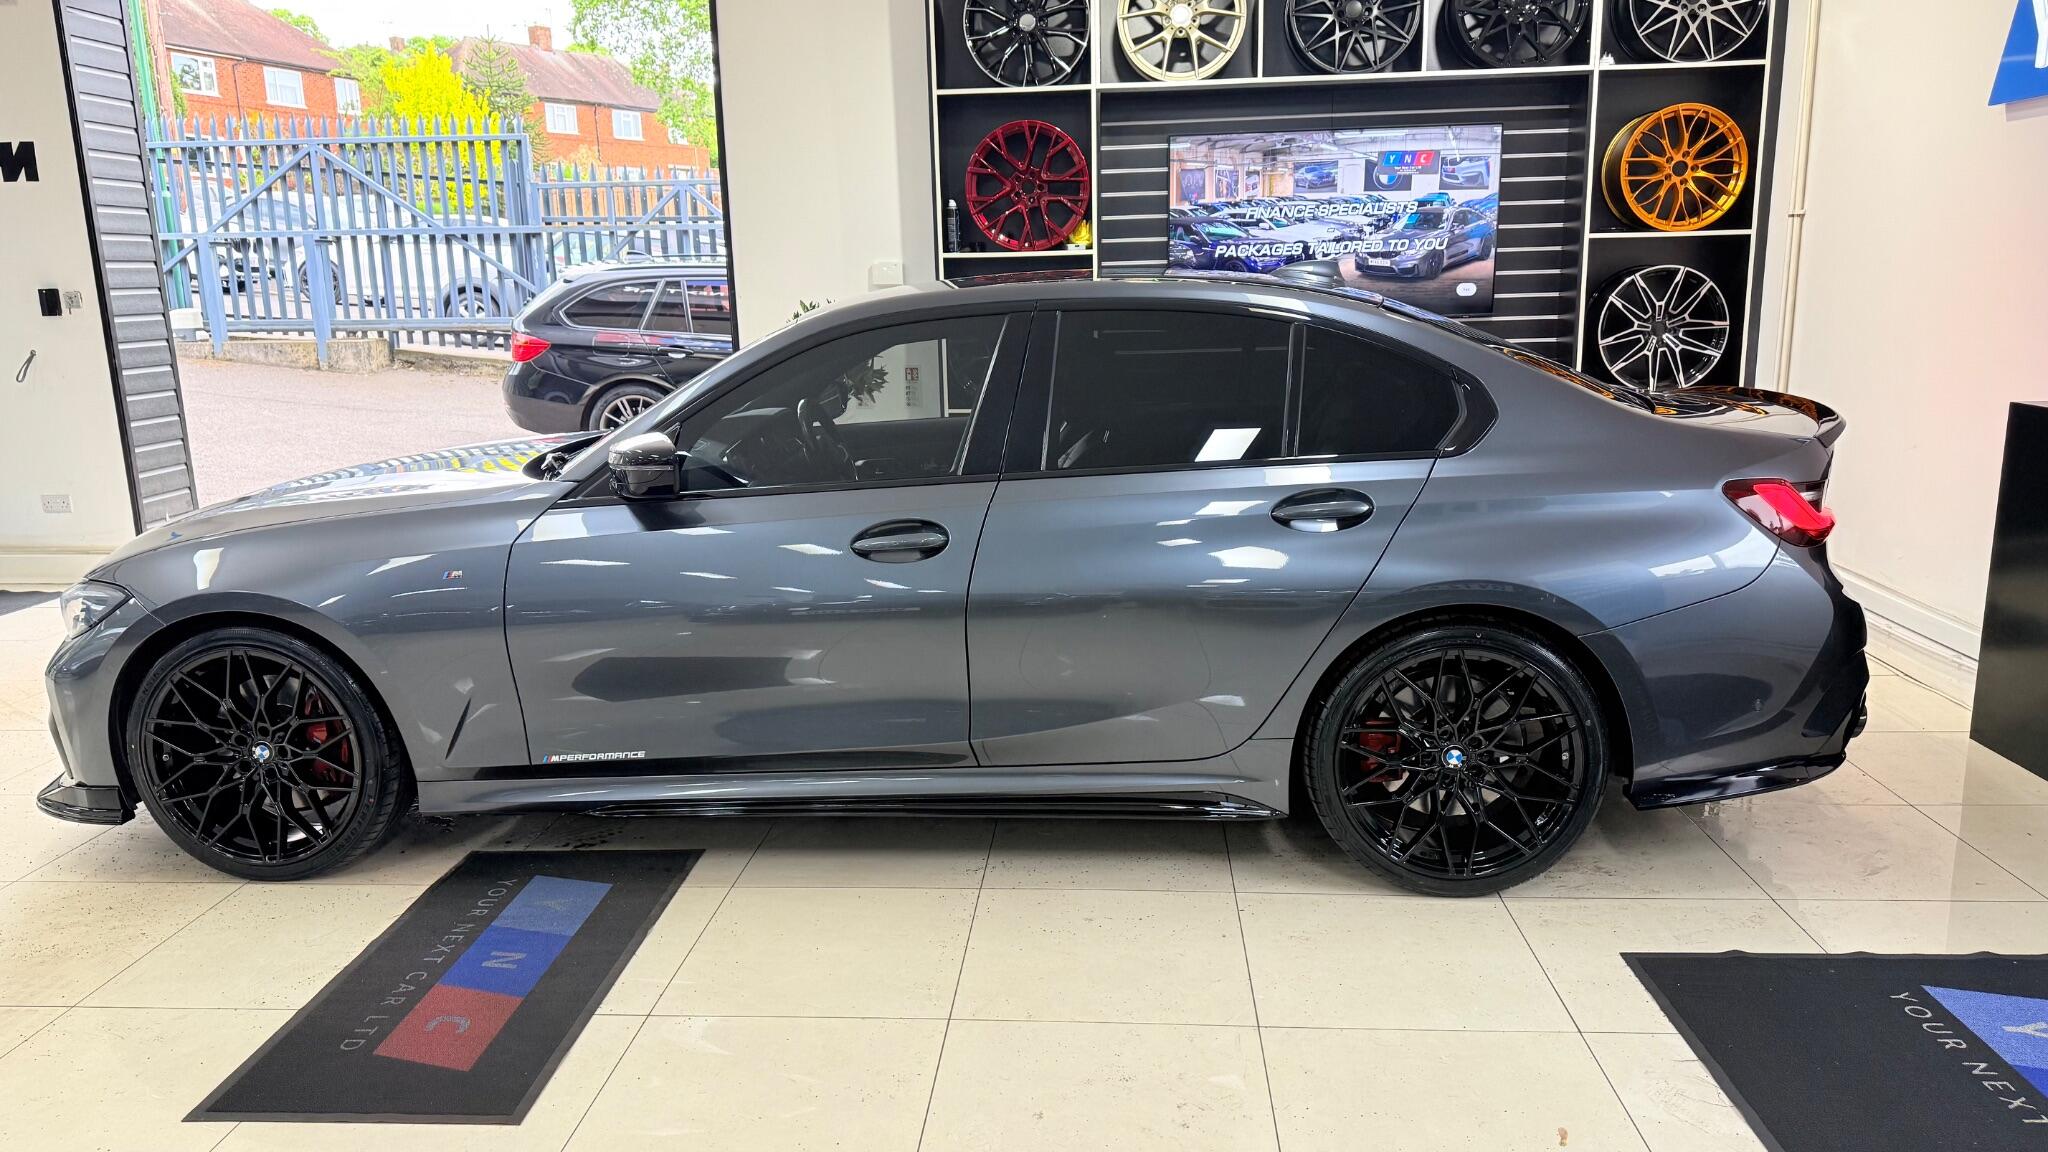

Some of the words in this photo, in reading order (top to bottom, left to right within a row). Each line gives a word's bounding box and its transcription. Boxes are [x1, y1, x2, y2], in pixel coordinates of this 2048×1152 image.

[1246, 205, 1317, 219] FINANCE
[1318, 201, 1418, 216] SPECIALISTS
[1214, 243, 1304, 257] PACKAGES
[1307, 240, 1383, 255] TAILORED
[1388, 239, 1409, 251] TO
[1414, 238, 1449, 251] YOU
[466, 879, 517, 916] YOUR
[424, 923, 476, 964] NEXT
[380, 971, 428, 1006] CAR
[339, 1015, 389, 1050] LTD
[1889, 991, 1967, 1049] YOUR
